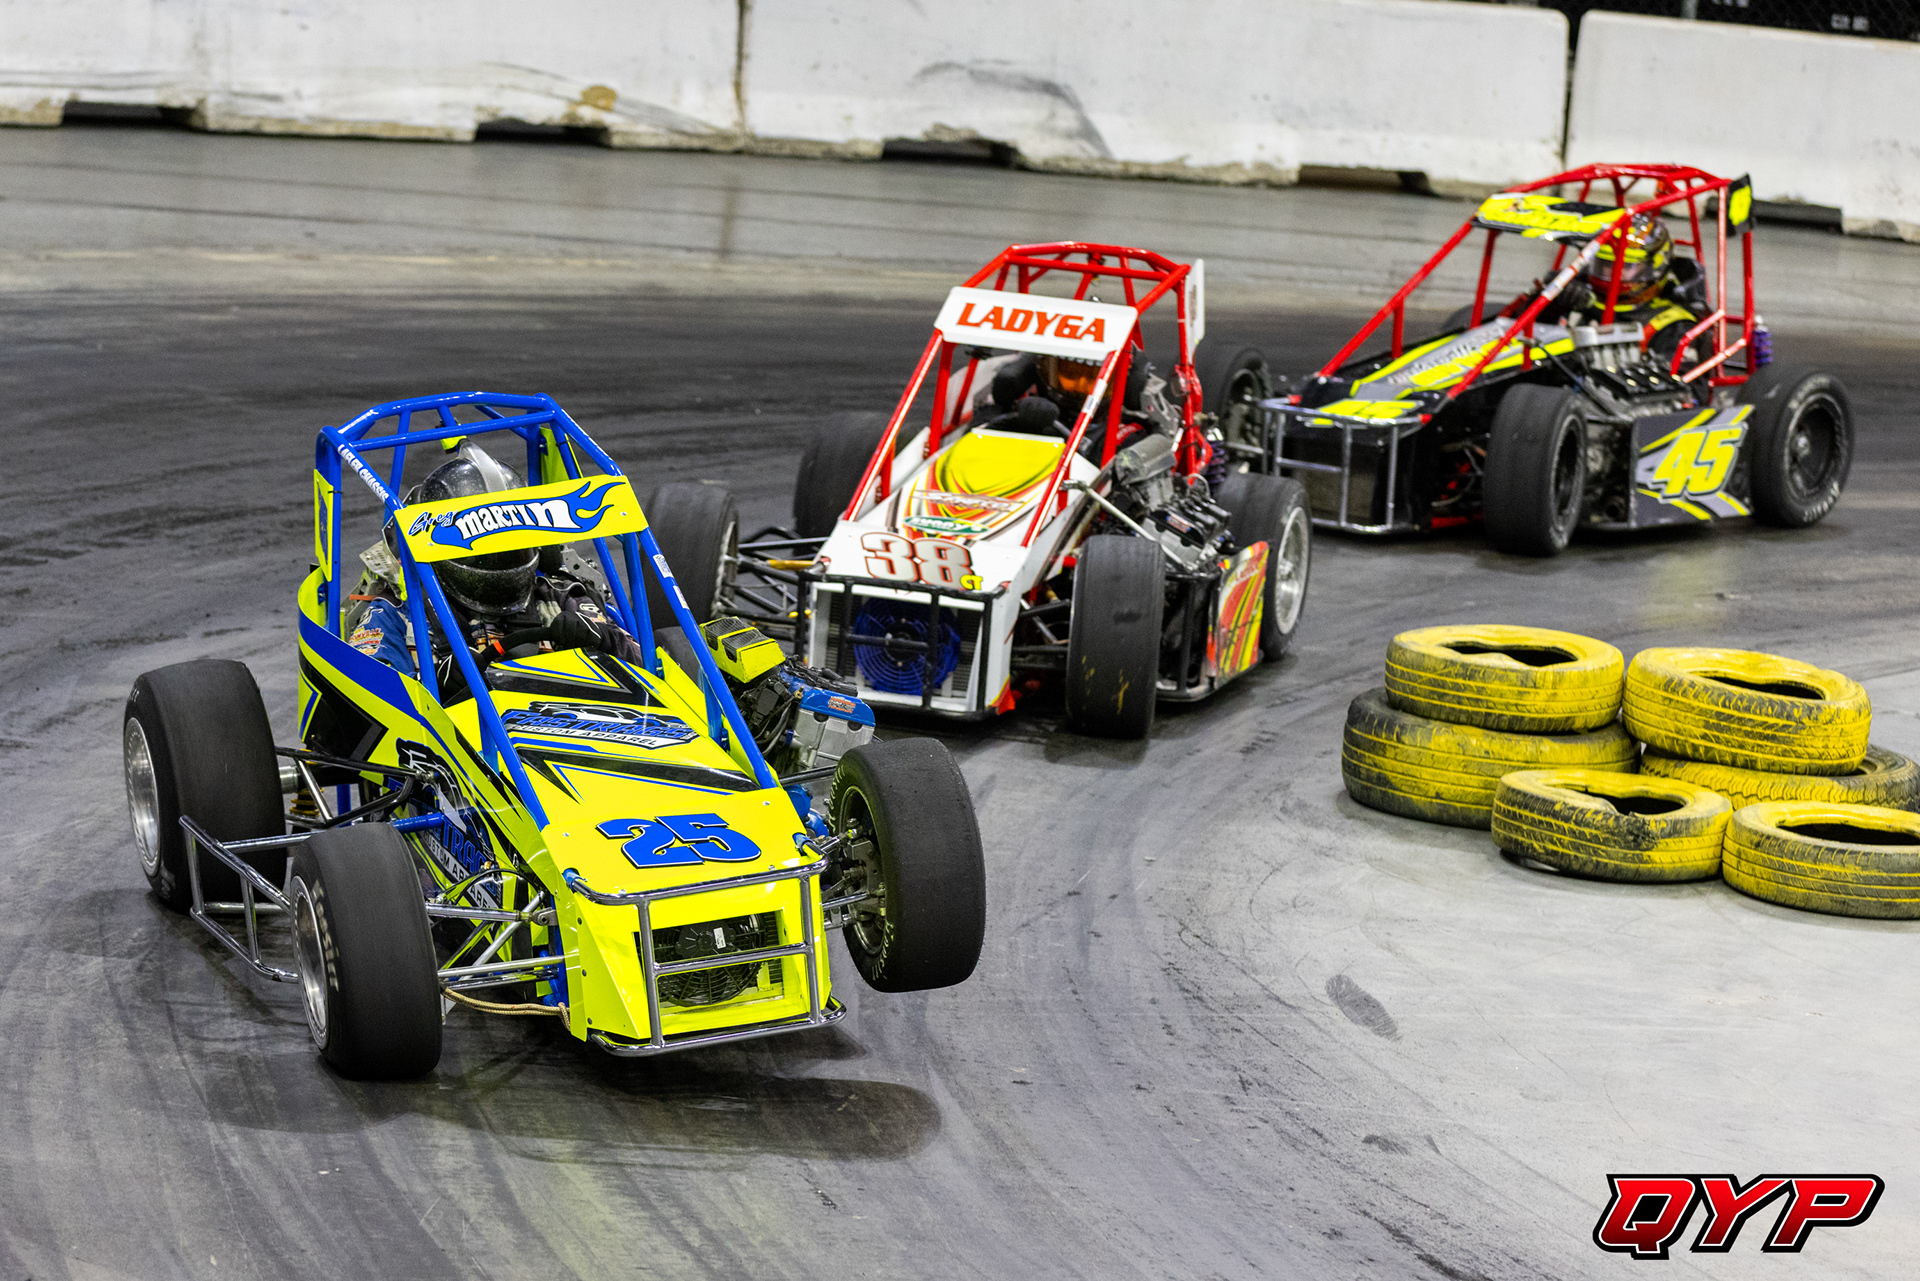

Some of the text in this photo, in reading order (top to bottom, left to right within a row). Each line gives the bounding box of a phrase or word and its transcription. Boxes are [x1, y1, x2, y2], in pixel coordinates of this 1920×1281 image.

[956, 302, 1106, 343] LADYGA
[1652, 425, 1746, 498] 45
[359, 468, 390, 503] CHASSIS
[408, 510, 460, 536] Greg
[861, 532, 974, 590] 38
[960, 575, 983, 590] CT
[579, 730, 656, 746] APPAREL
[595, 813, 761, 869] 25
